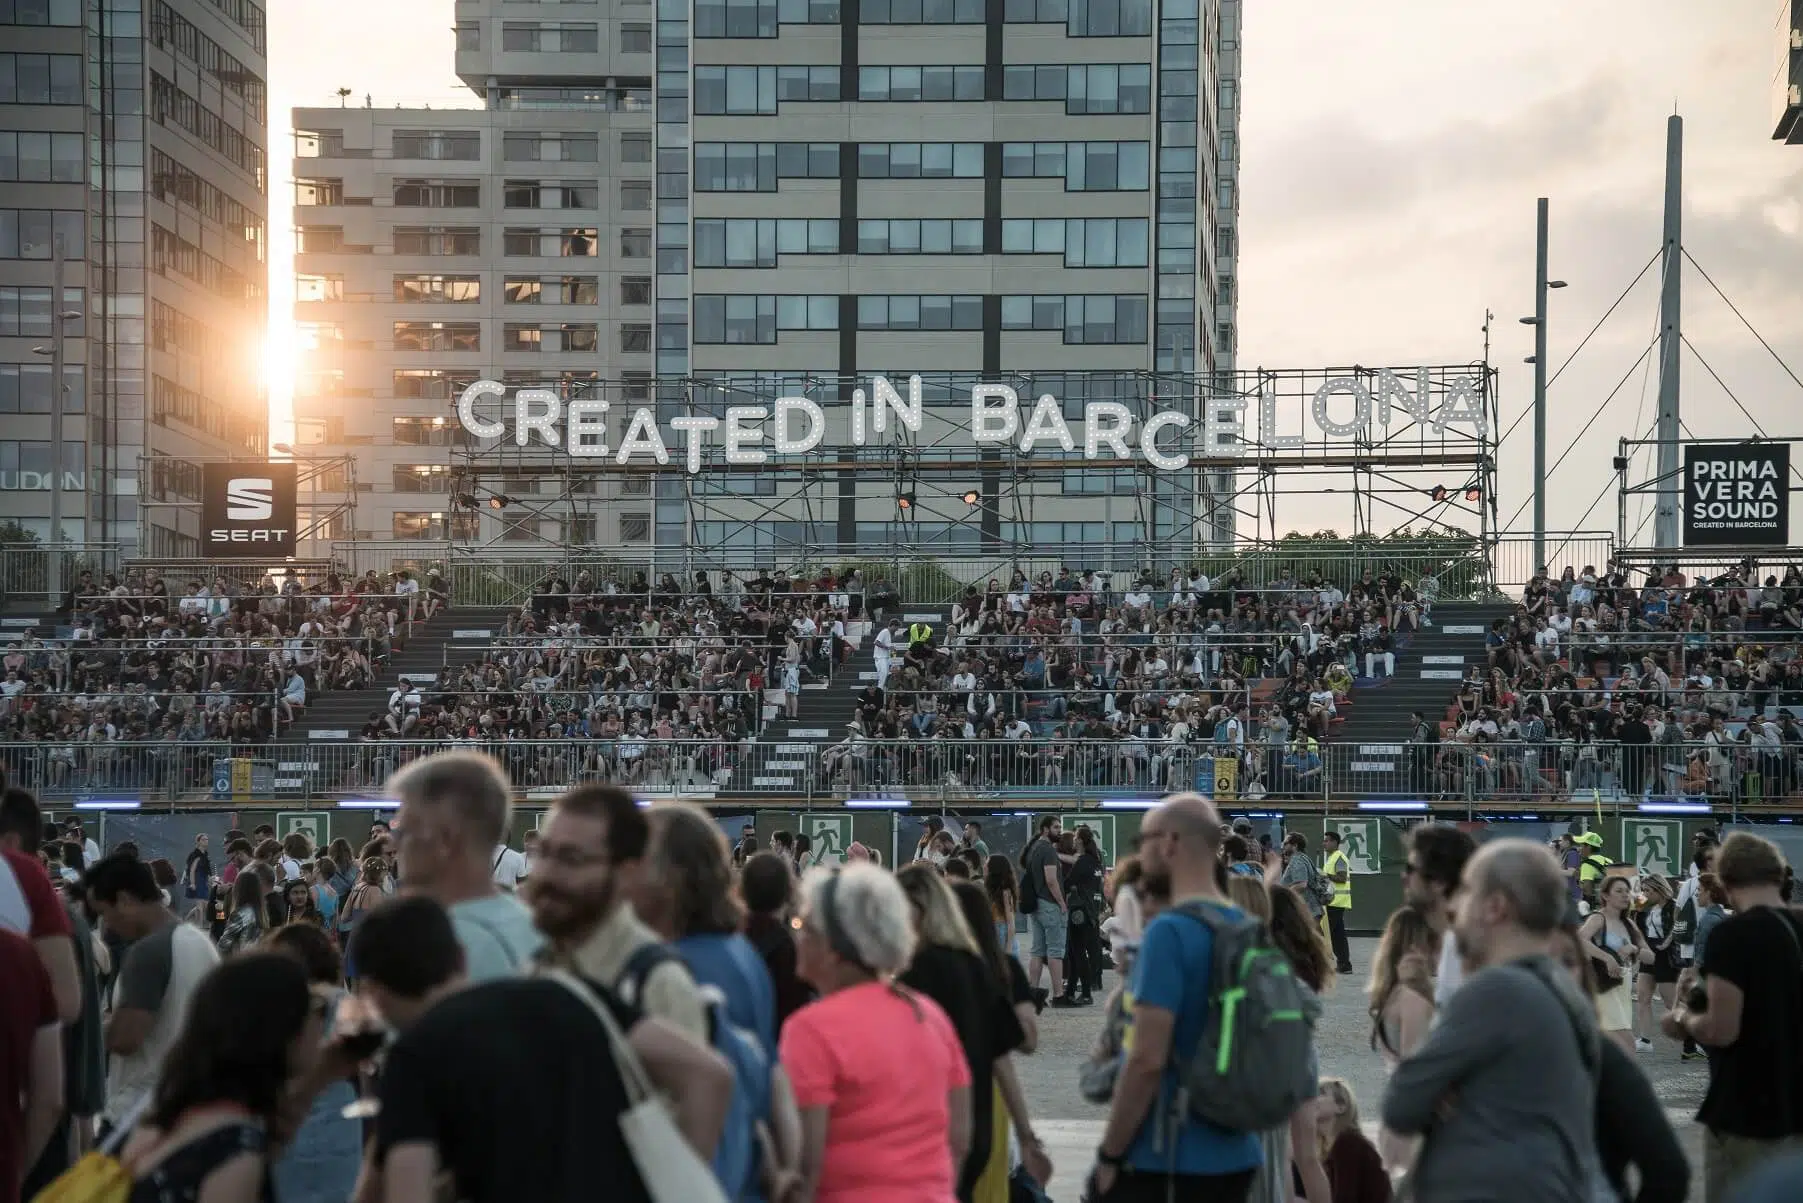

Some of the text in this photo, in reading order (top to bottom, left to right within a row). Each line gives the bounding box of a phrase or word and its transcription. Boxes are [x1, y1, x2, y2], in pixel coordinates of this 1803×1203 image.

[458, 366, 1489, 474] CREATED IN BARCELONA
[1693, 460, 1778, 479] PRIMA
[1693, 481, 1778, 500] VERA
[1693, 502, 1778, 519] SOUND
[211, 529, 288, 542] SEAT
